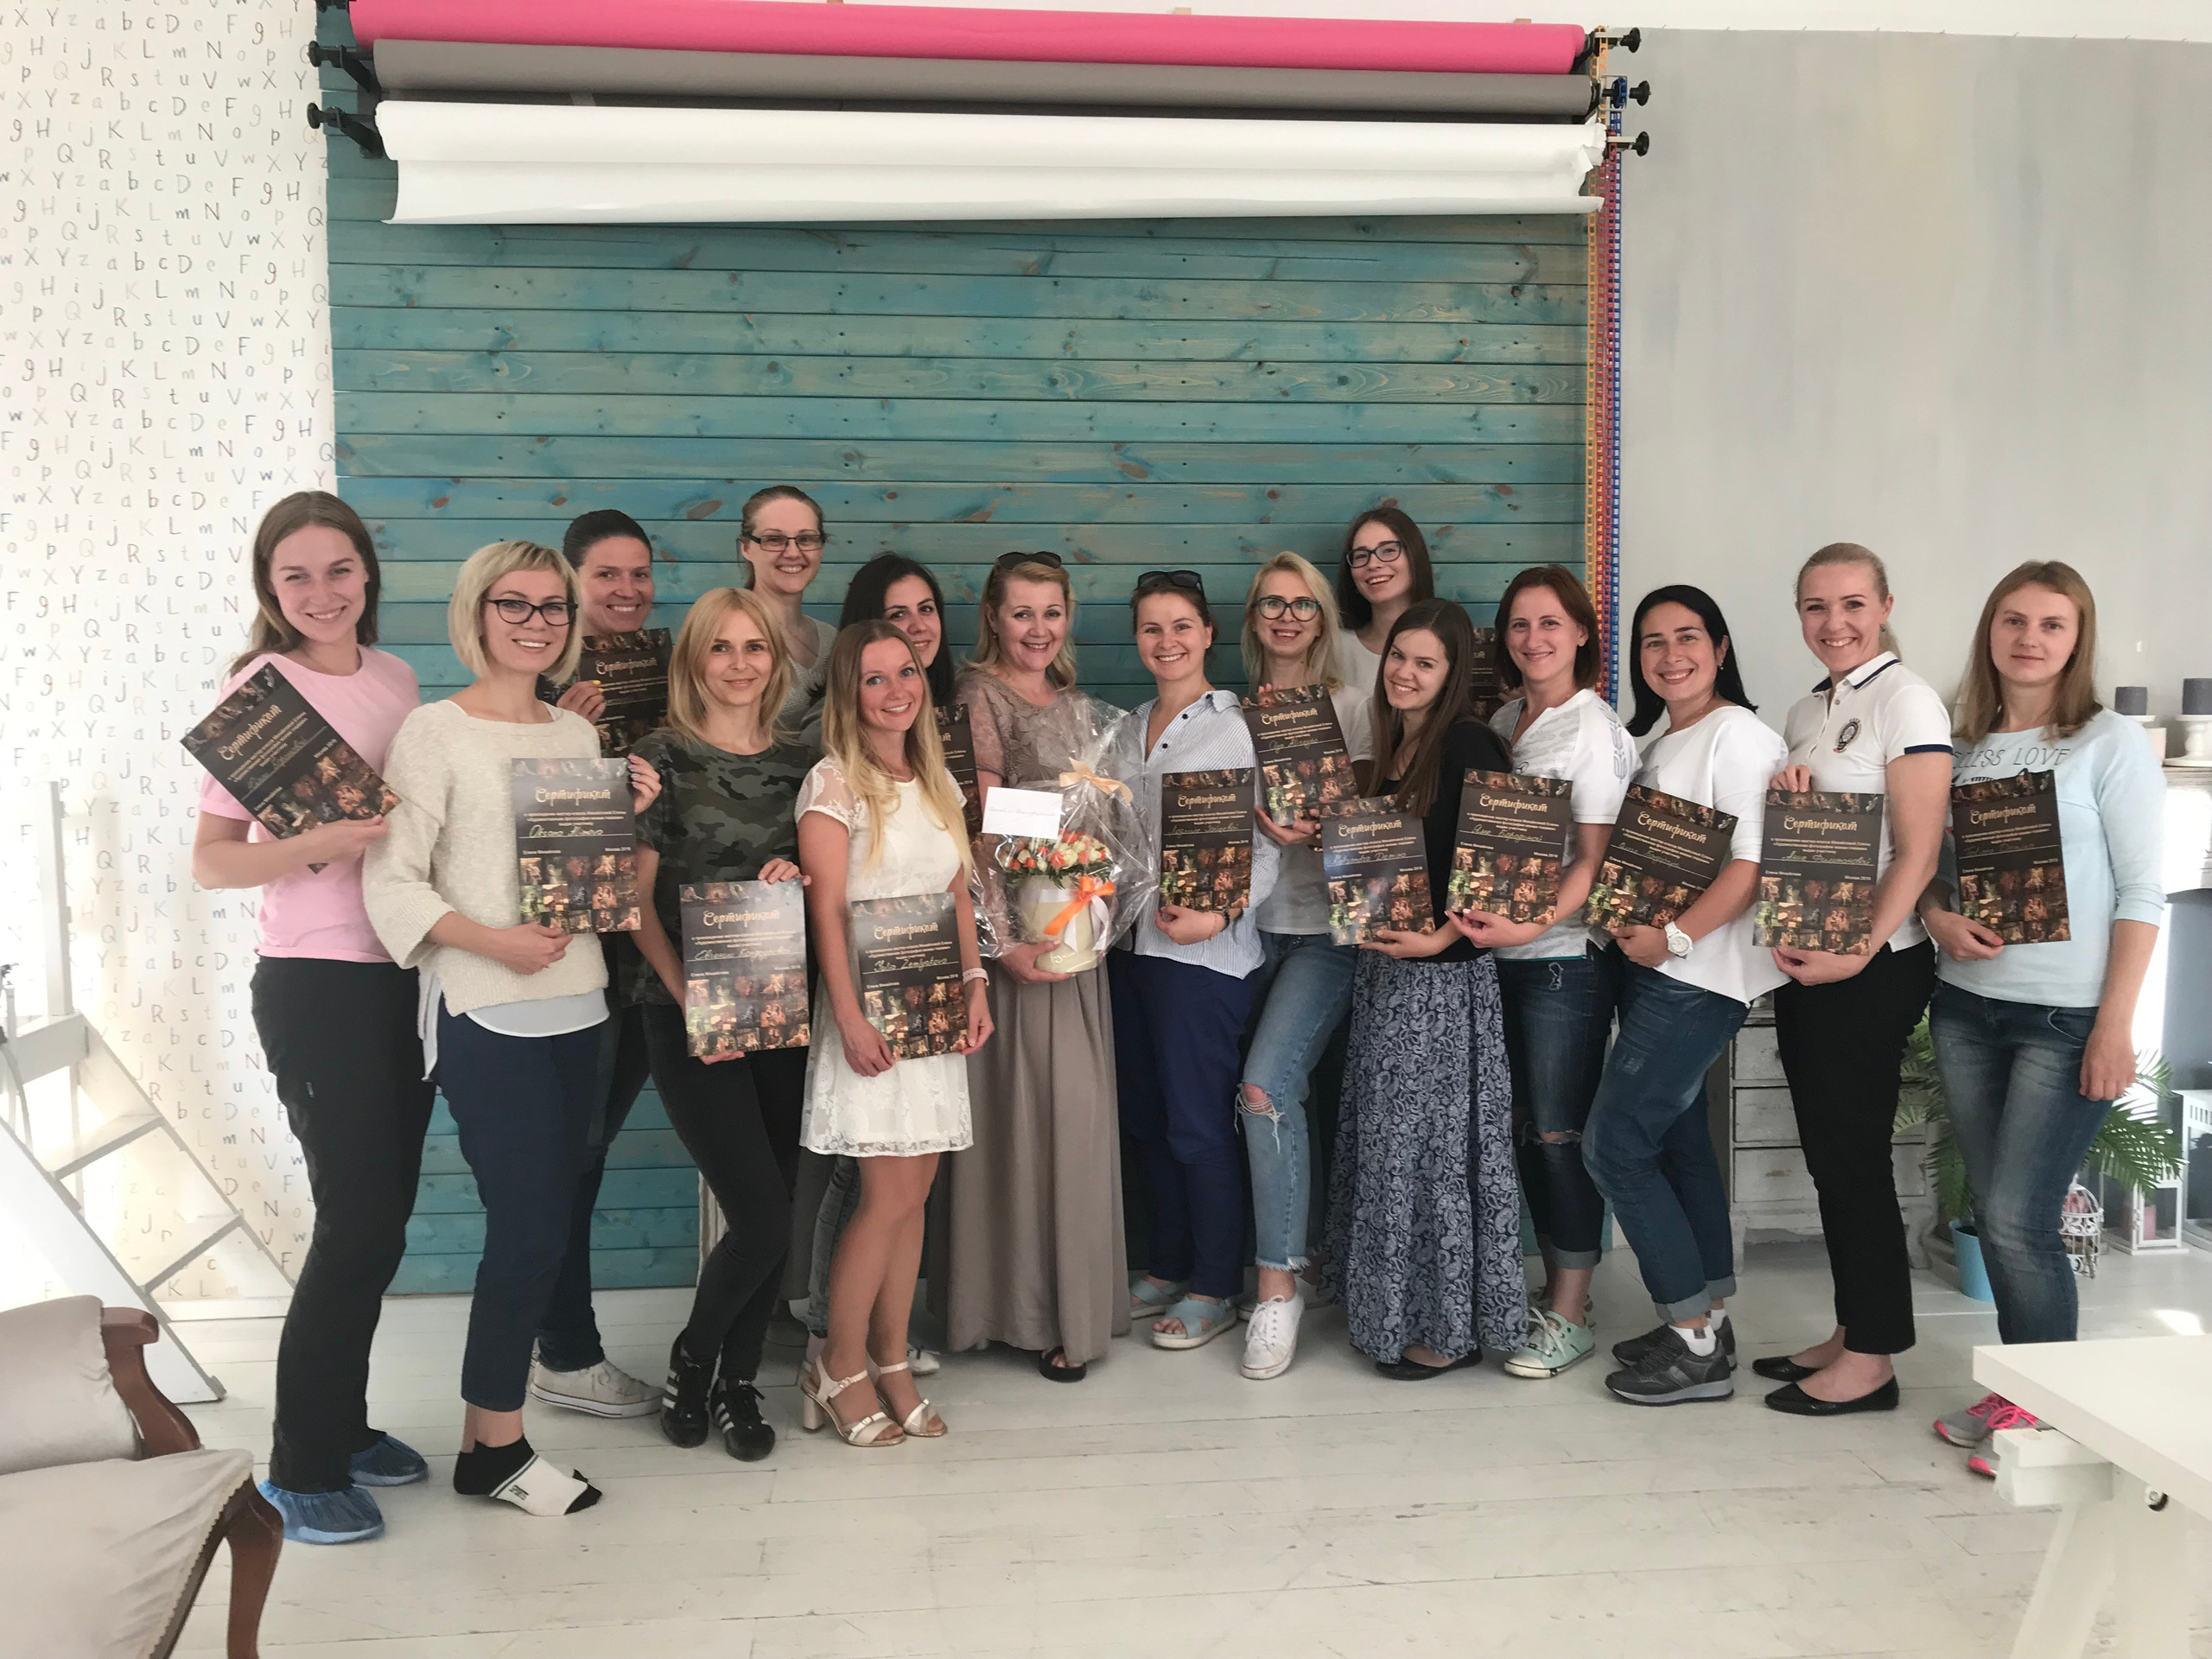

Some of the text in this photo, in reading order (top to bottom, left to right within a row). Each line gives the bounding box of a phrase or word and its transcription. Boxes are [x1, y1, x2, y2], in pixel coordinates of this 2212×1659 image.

[46, 7, 60, 29] Y
[122, 11, 134, 33] b
[146, 16, 156, 31] c
[165, 14, 181, 35] D
[251, 22, 266, 47] g
[143, 39, 157, 60] L
[207, 41, 224, 61] N
[22, 66, 33, 85] p
[101, 67, 116, 89] R
[130, 73, 141, 88] s
[202, 71, 219, 91] V
[262, 70, 278, 91] X
[294, 71, 308, 92] Y
[45, 88, 59, 110] Y
[149, 100, 159, 115] c
[172, 97, 188, 118] D
[226, 98, 239, 119] F
[10, 119, 24, 143] g
[36, 118, 53, 140] H
[198, 123, 215, 143] N
[270, 129, 282, 148] p
[57, 143, 309, 173] Q R t u Y
[128, 170, 140, 193] b
[232, 177, 246, 199] F
[260, 182, 275, 207] g
[287, 181, 302, 203] H
[14, 200, 29, 224] g
[175, 208, 192, 221] m
[205, 202, 222, 222] N
[135, 229, 145, 244] s
[247, 234, 262, 247] w
[302, 234, 316, 254] Y
[134, 251, 147, 273] b
[158, 257, 169, 271] c
[177, 255, 194, 276] D
[264, 262, 278, 286] g
[156, 280, 237, 301] L N
[33, 306, 45, 324] p
[113, 307, 130, 329] R
[144, 314, 154, 328] s
[216, 311, 232, 330] V
[307, 309, 321, 330] Y
[162, 340, 173, 353] c
[238, 337, 252, 358] F
[22, 359, 36, 383] g
[48, 357, 65, 379] H
[211, 361, 229, 381] N
[283, 367, 295, 385] p
[70, 383, 181, 410] Q R t
[8, 410, 24, 423] w
[142, 410, 154, 430] b
[245, 415, 258, 435] F
[273, 419, 287, 443] g
[299, 417, 314, 439] H
[26, 439, 235, 462] g m N
[149, 467, 159, 481] s
[259, 470, 275, 483] w
[148, 489, 161, 510] b
[168, 517, 183, 537] L
[47, 543, 59, 562] p
[181, 623, 194, 640] t
[22, 647, 38, 659] w
[201, 679, 217, 691] m
[2013, 747, 2070, 766] LOVE
[1479, 792, 1548, 814] Сертификат
[1637, 810, 1707, 844] Сертификат
[1783, 815, 1858, 836] Сертификат
[213, 908, 228, 920] m
[203, 1080, 215, 1097] t
[222, 1135, 238, 1146] m
[263, 1200, 281, 1218] N
